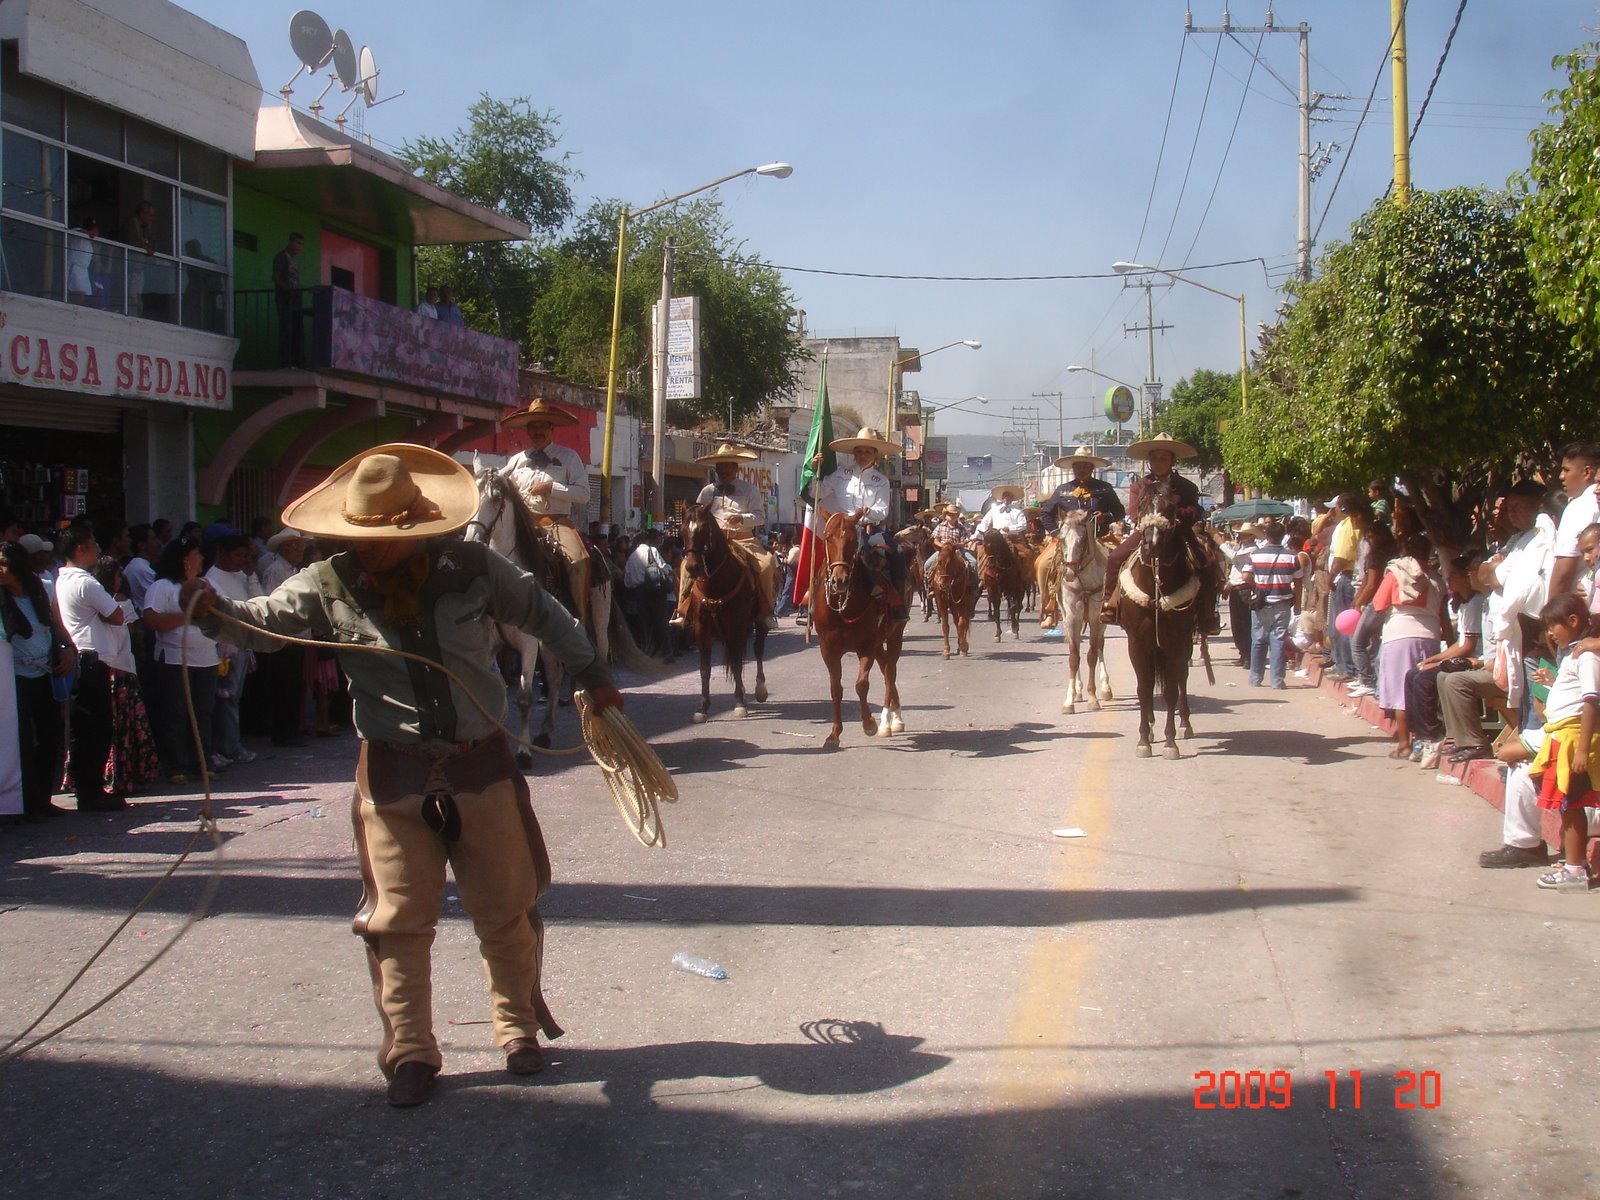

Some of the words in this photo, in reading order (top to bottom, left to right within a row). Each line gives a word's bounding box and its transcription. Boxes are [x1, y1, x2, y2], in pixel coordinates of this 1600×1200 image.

[669, 354, 693, 363] RENTA
[11, 335, 101, 385] CASA
[116, 352, 227, 400] SEDANO
[669, 376, 693, 385] RENTA
